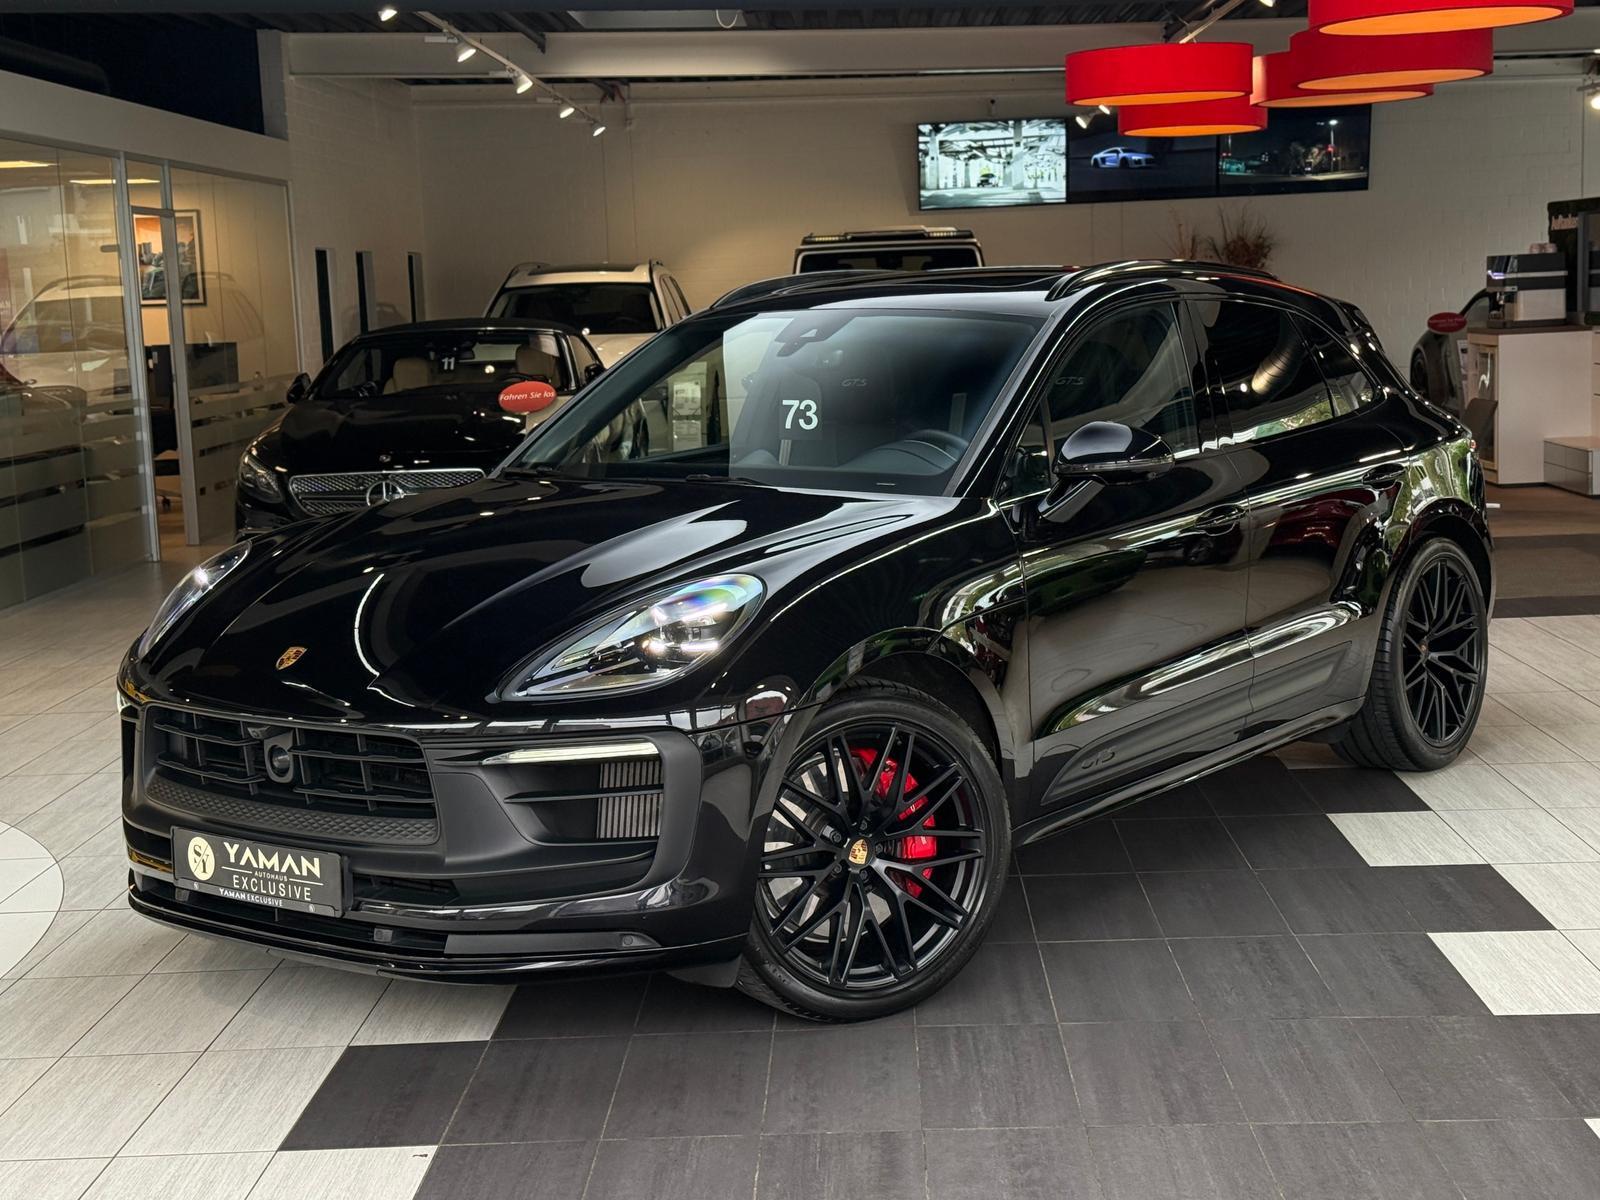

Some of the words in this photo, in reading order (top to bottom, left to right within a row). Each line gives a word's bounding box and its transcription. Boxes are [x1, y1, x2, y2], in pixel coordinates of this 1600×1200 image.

[442, 356, 456, 371] 11
[499, 389, 528, 401] Fahren
[529, 390, 542, 400] Sie
[543, 389, 554, 399] los
[782, 399, 818, 430] 73
[223, 841, 321, 879] YAMAN
[254, 870, 289, 882] AUTOHAUS
[218, 887, 246, 900] YAMAN
[246, 893, 284, 907] EXCLUSIVE
[232, 874, 313, 901] EXCLUSIVE
